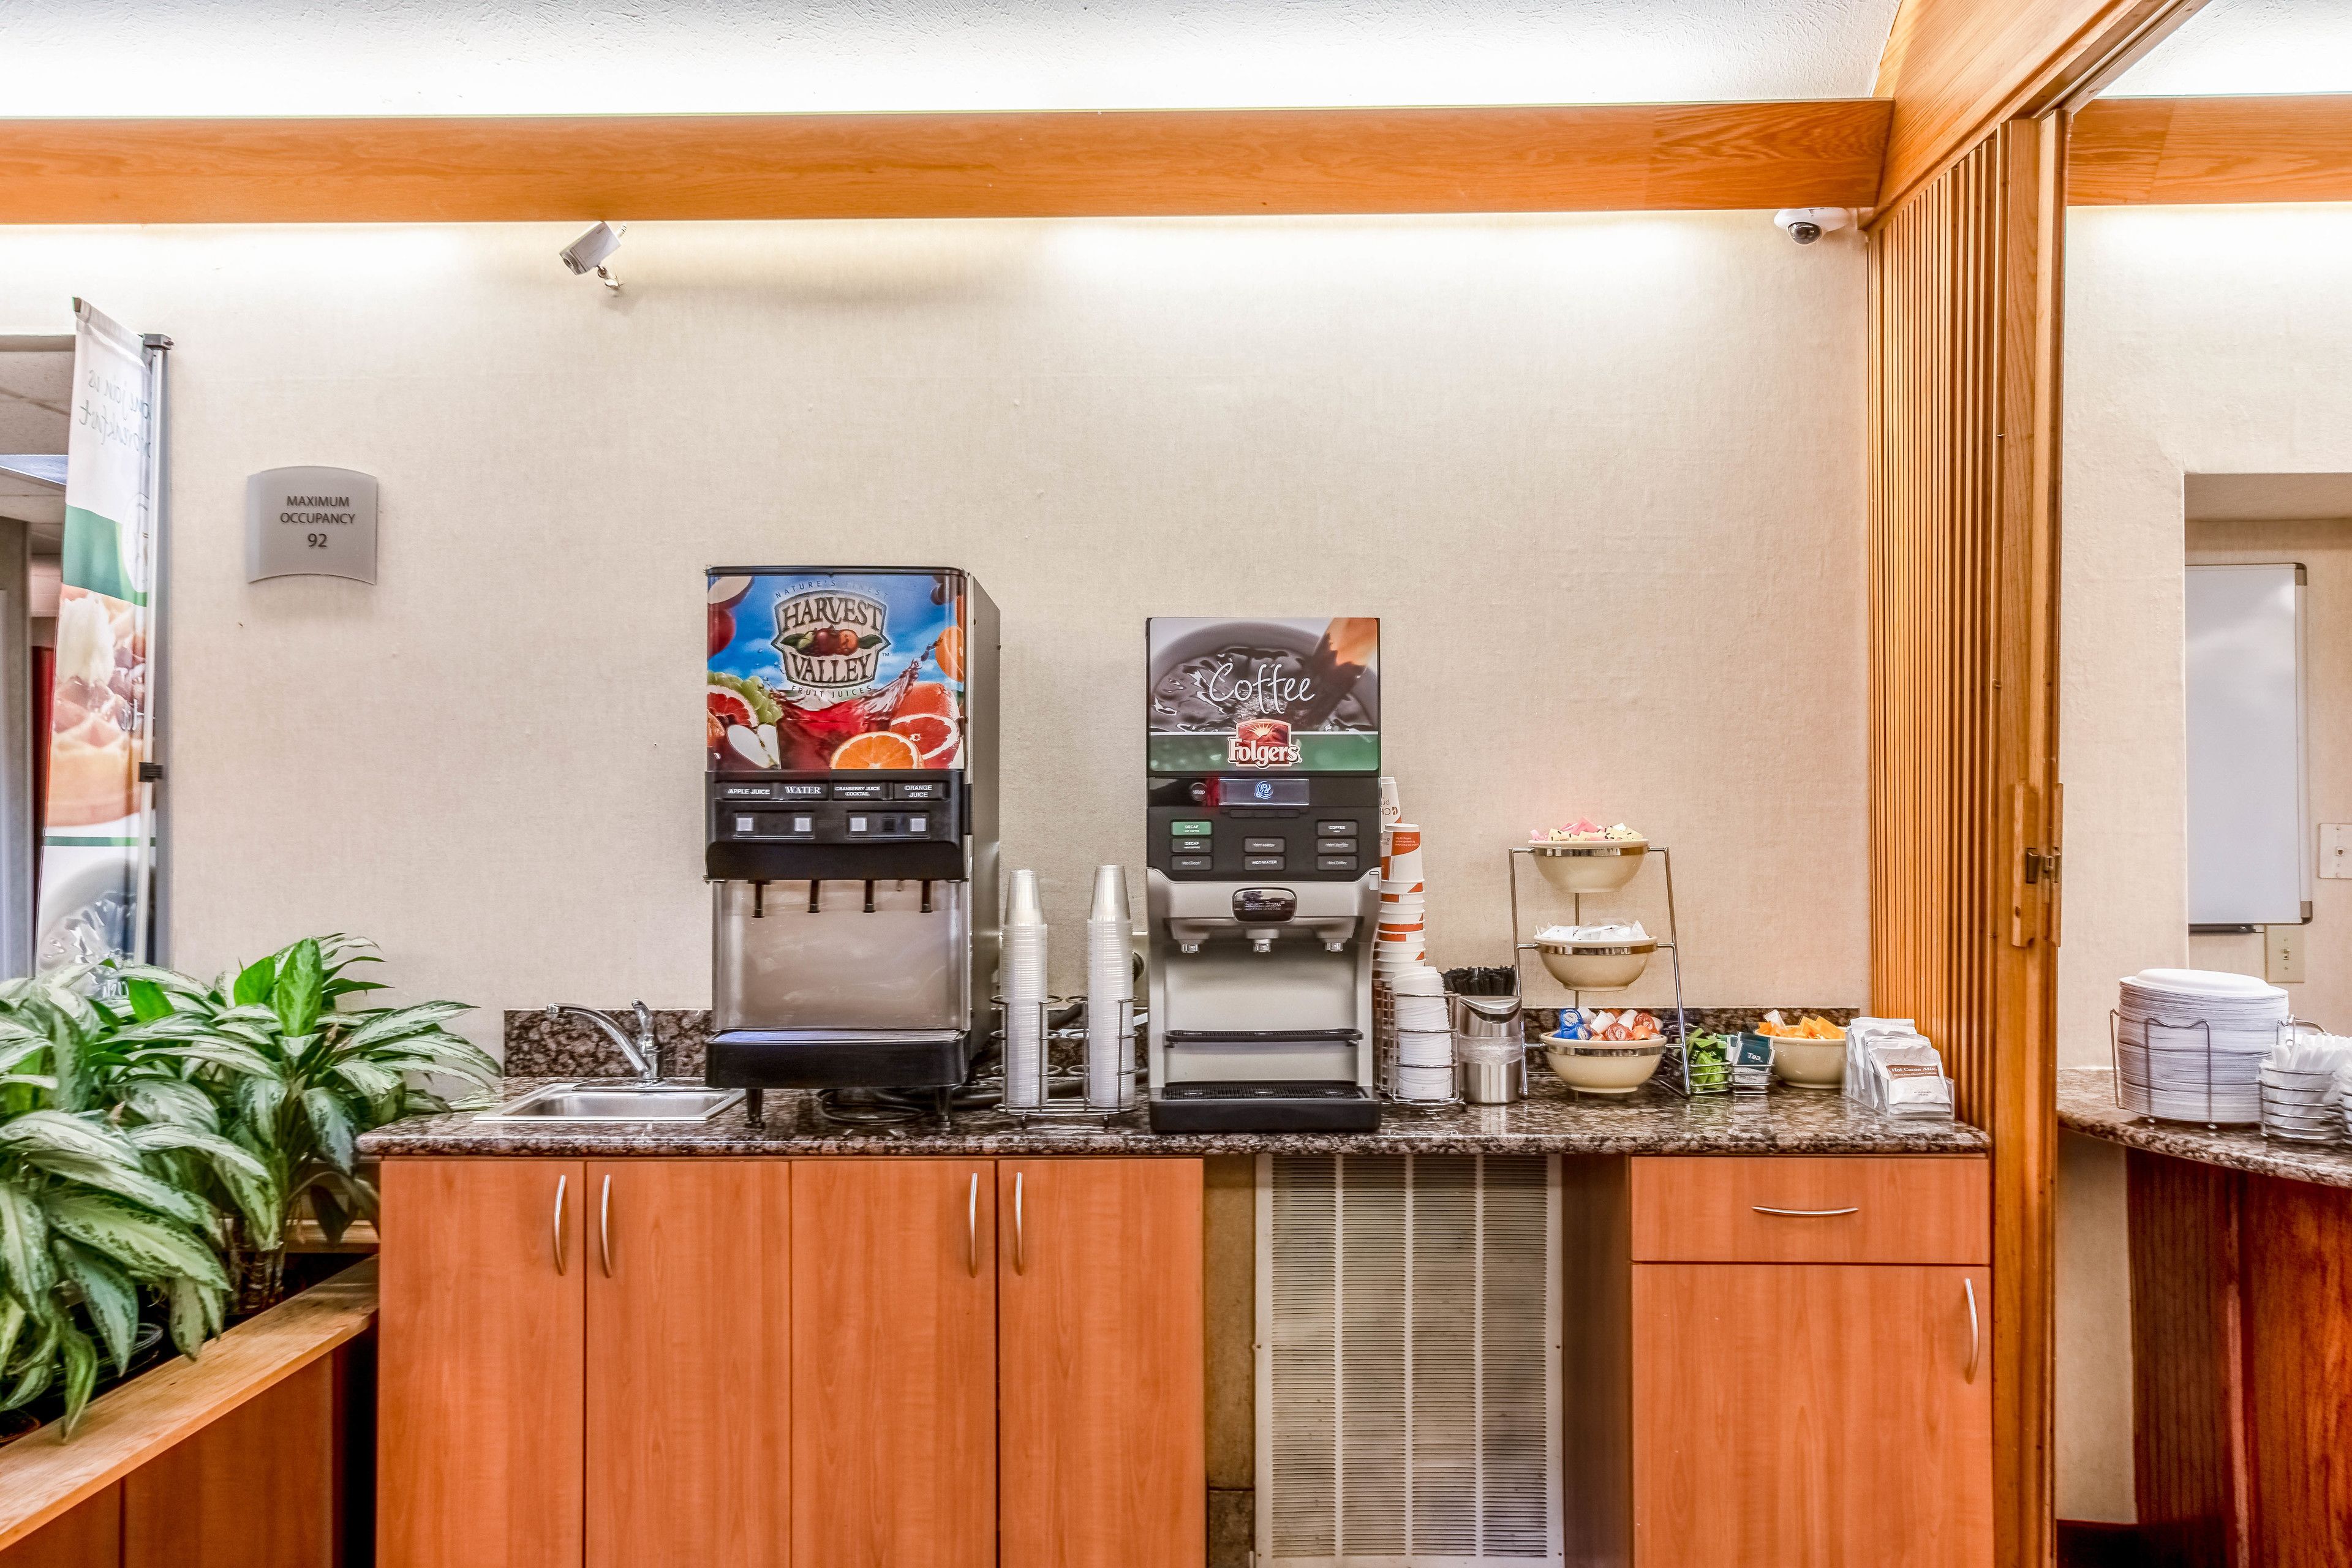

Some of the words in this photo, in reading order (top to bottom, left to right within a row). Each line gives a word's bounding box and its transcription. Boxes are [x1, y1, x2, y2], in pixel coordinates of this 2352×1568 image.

[287, 496, 350, 507] MAXIMUM
[280, 512, 355, 524] OCCUPANCY
[307, 533, 327, 547] 92
[775, 579, 836, 599] NATURE'S
[845, 581, 889, 600] FINEST
[782, 597, 883, 633] HARVEST
[790, 652, 872, 684] VALLEY
[791, 685, 824, 697] FRUIT
[831, 685, 872, 699] JUICES
[1209, 662, 1315, 714] Coffee
[1228, 737, 1300, 767] Folgers
[785, 786, 822, 794] WATER
[1747, 1052, 1762, 1061] Tea
